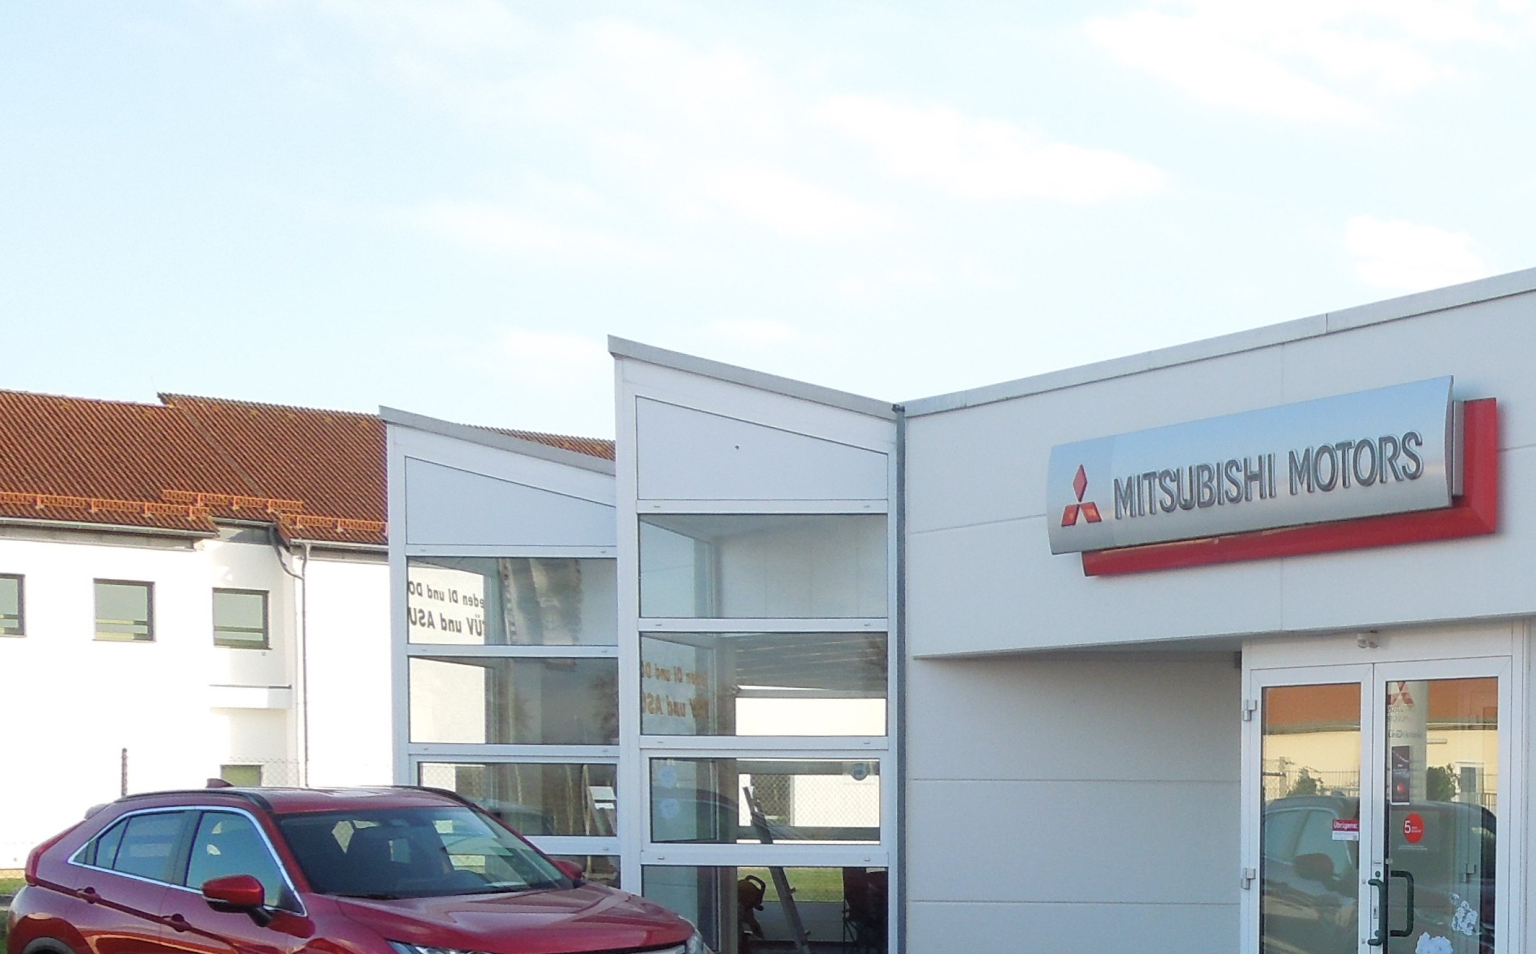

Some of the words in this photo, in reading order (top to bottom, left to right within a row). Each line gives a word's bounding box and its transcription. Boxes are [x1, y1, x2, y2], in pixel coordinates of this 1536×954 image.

[1113, 452, 1277, 521] MITSUBISHI
[1288, 430, 1425, 496] MOTORS
[1404, 820, 1411, 834] 5
